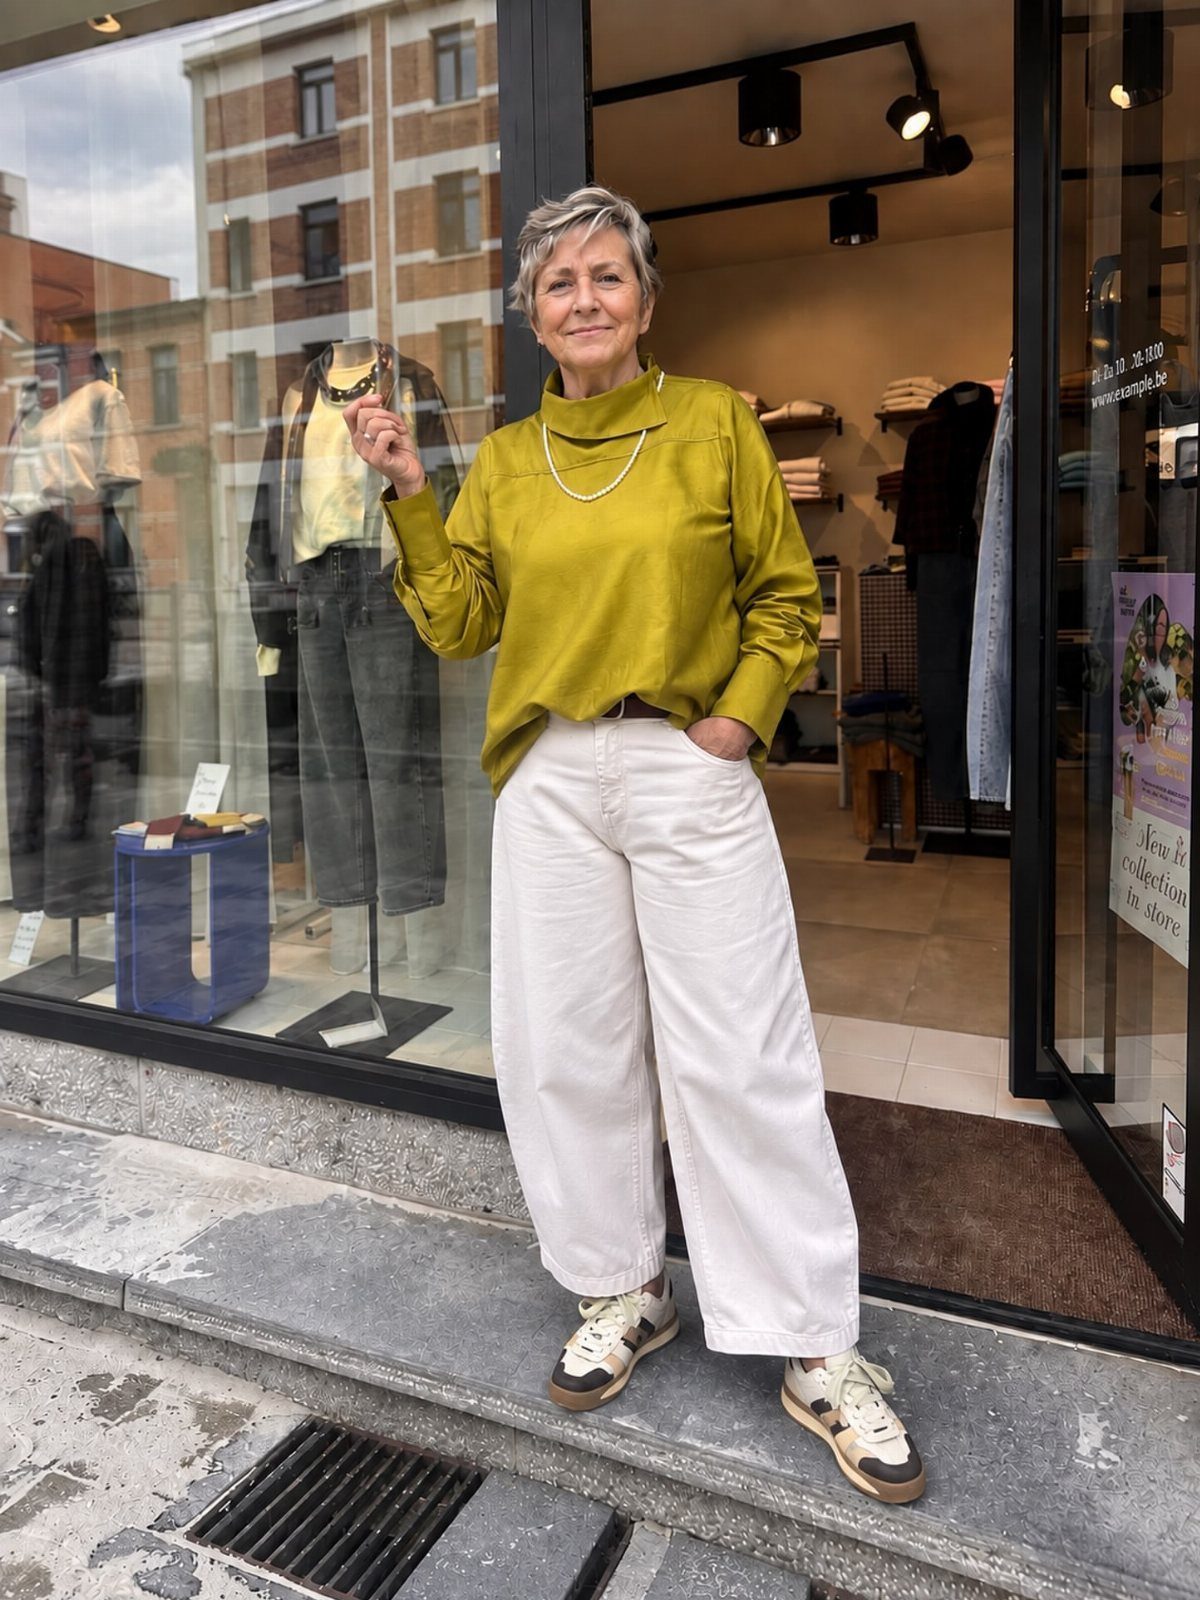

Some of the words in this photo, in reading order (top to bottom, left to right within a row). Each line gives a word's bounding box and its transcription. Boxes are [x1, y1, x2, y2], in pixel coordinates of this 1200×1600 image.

[1091, 370, 1168, 410] www.example.be
[1136, 823, 1171, 860] New
[1122, 855, 1188, 909] collection
[1126, 885, 1140, 911] in
[1144, 901, 1182, 938] store
